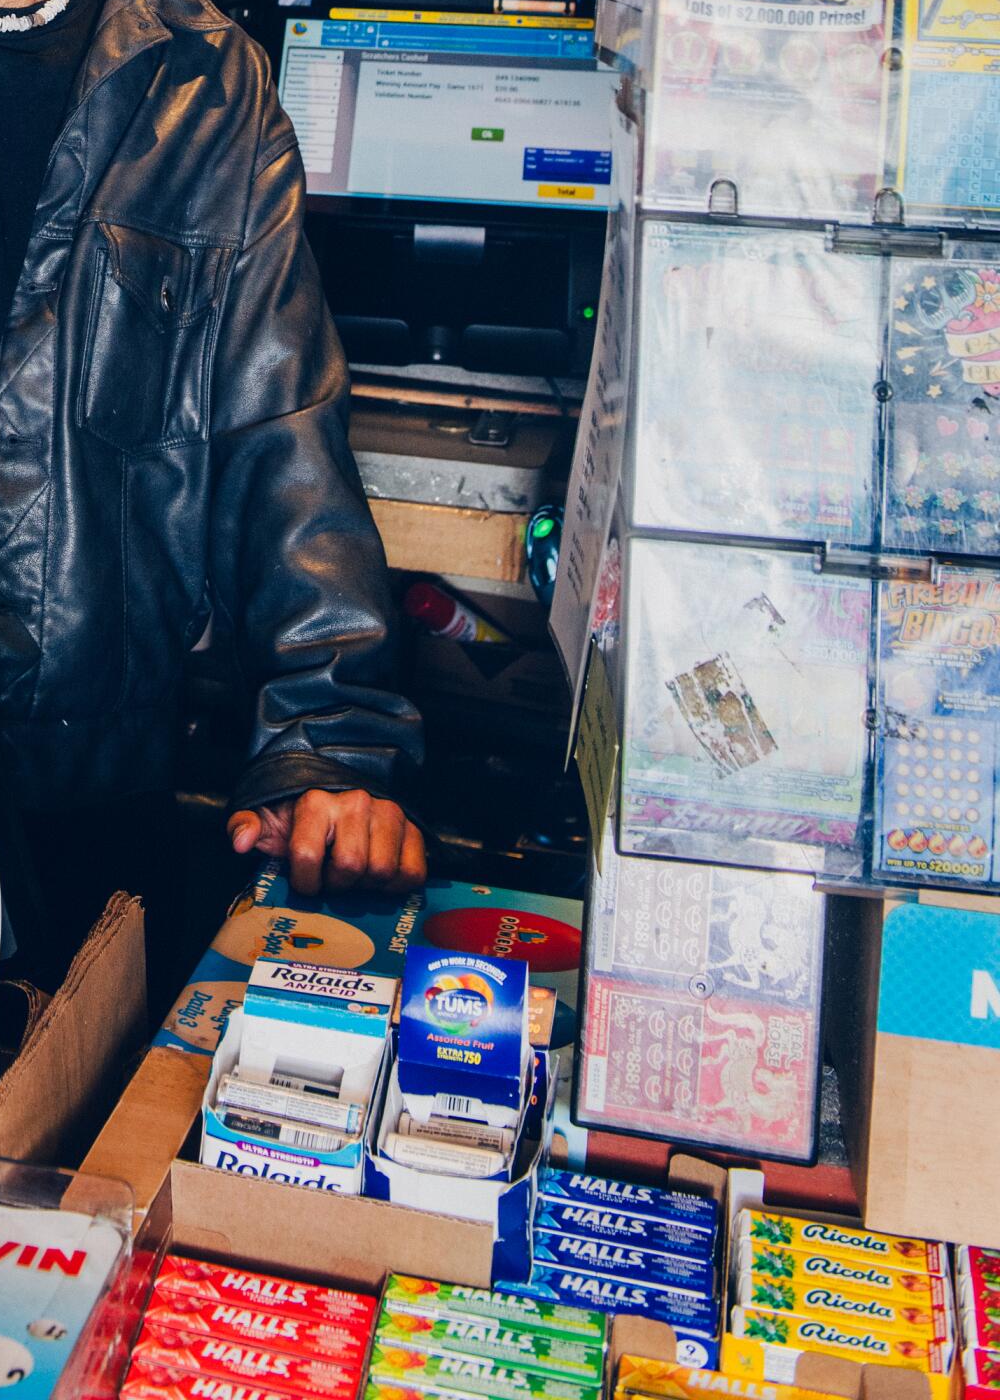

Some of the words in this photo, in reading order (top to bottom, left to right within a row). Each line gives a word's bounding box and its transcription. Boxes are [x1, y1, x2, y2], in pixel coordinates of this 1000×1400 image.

[557, 187, 576, 197] Total
[902, 610, 993, 648] BINGO
[271, 966, 376, 994] Rolaids
[293, 963, 321, 972] ULTRA
[322, 965, 359, 976] STRENGTH
[284, 980, 357, 998] ANTACID
[436, 995, 483, 1016] TUMS
[427, 1032, 472, 1048] Assorted
[473, 1039, 495, 1051] Fruit
[437, 1046, 463, 1058] EXTRA
[769, 1015, 781, 1068] HORSE
[464, 1050, 482, 1066] 750
[242, 1142, 271, 1156] ULTRA
[271, 1147, 316, 1168] STRENGTH
[570, 1174, 653, 1205] HALLS
[562, 1206, 647, 1237] HALLS
[559, 1237, 645, 1269] HALLS
[803, 1223, 890, 1254] Ricola
[804, 1256, 892, 1288] Ricola
[222, 1272, 307, 1306] HALLS
[453, 1286, 540, 1312] HALLS
[560, 1274, 649, 1308] HALLS
[806, 1289, 893, 1321] Ricola
[211, 1306, 299, 1340] HALLS
[444, 1320, 535, 1352] HALLS
[800, 1321, 889, 1354] Ricola
[202, 1342, 291, 1378] HALLS
[440, 1356, 527, 1389] HALLS
[688, 1371, 779, 1399] HALLS
